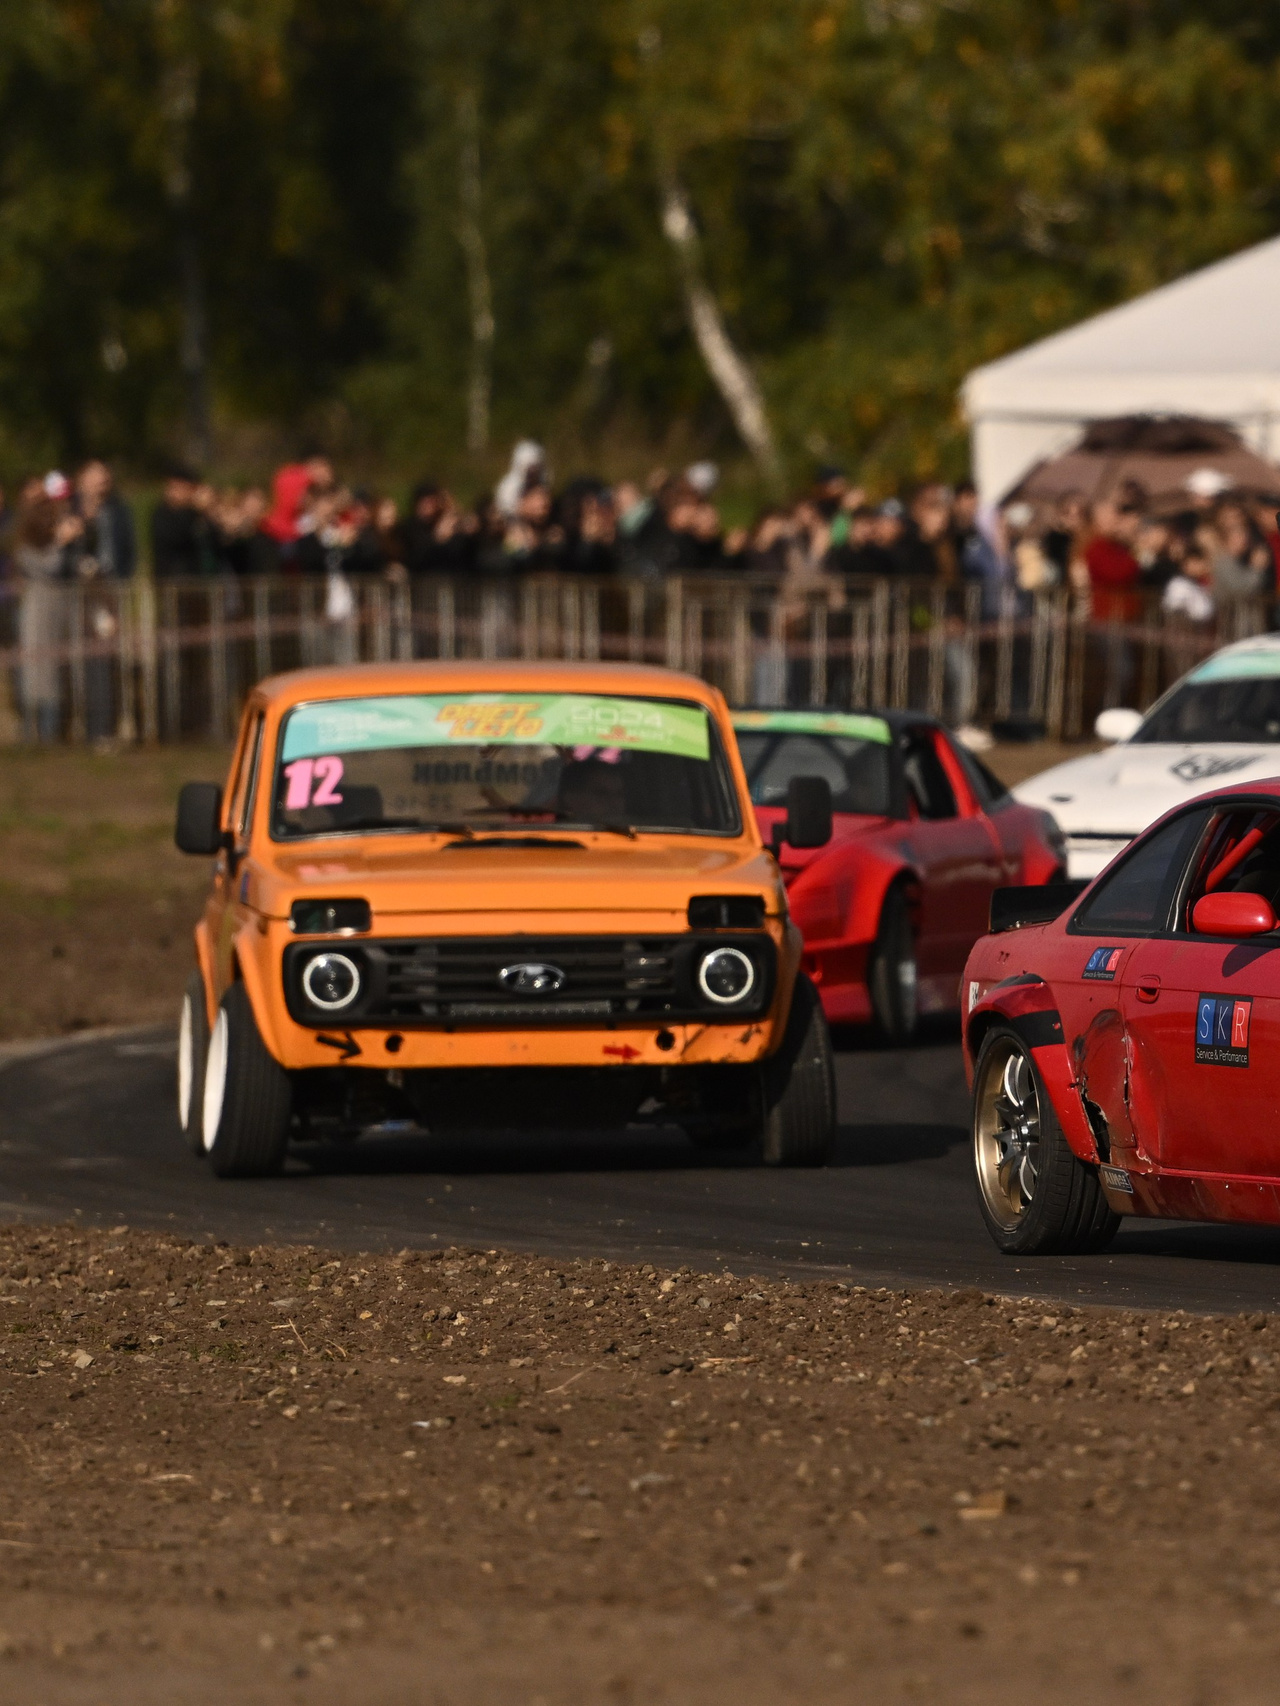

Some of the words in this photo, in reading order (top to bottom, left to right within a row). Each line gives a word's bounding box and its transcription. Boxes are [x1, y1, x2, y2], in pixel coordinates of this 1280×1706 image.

[284, 755, 344, 811] 12
[1089, 951, 1120, 968] SKR
[1200, 1004, 1246, 1042] SKR
[1196, 1047, 1213, 1060] Service
[1214, 1049, 1219, 1060] &
